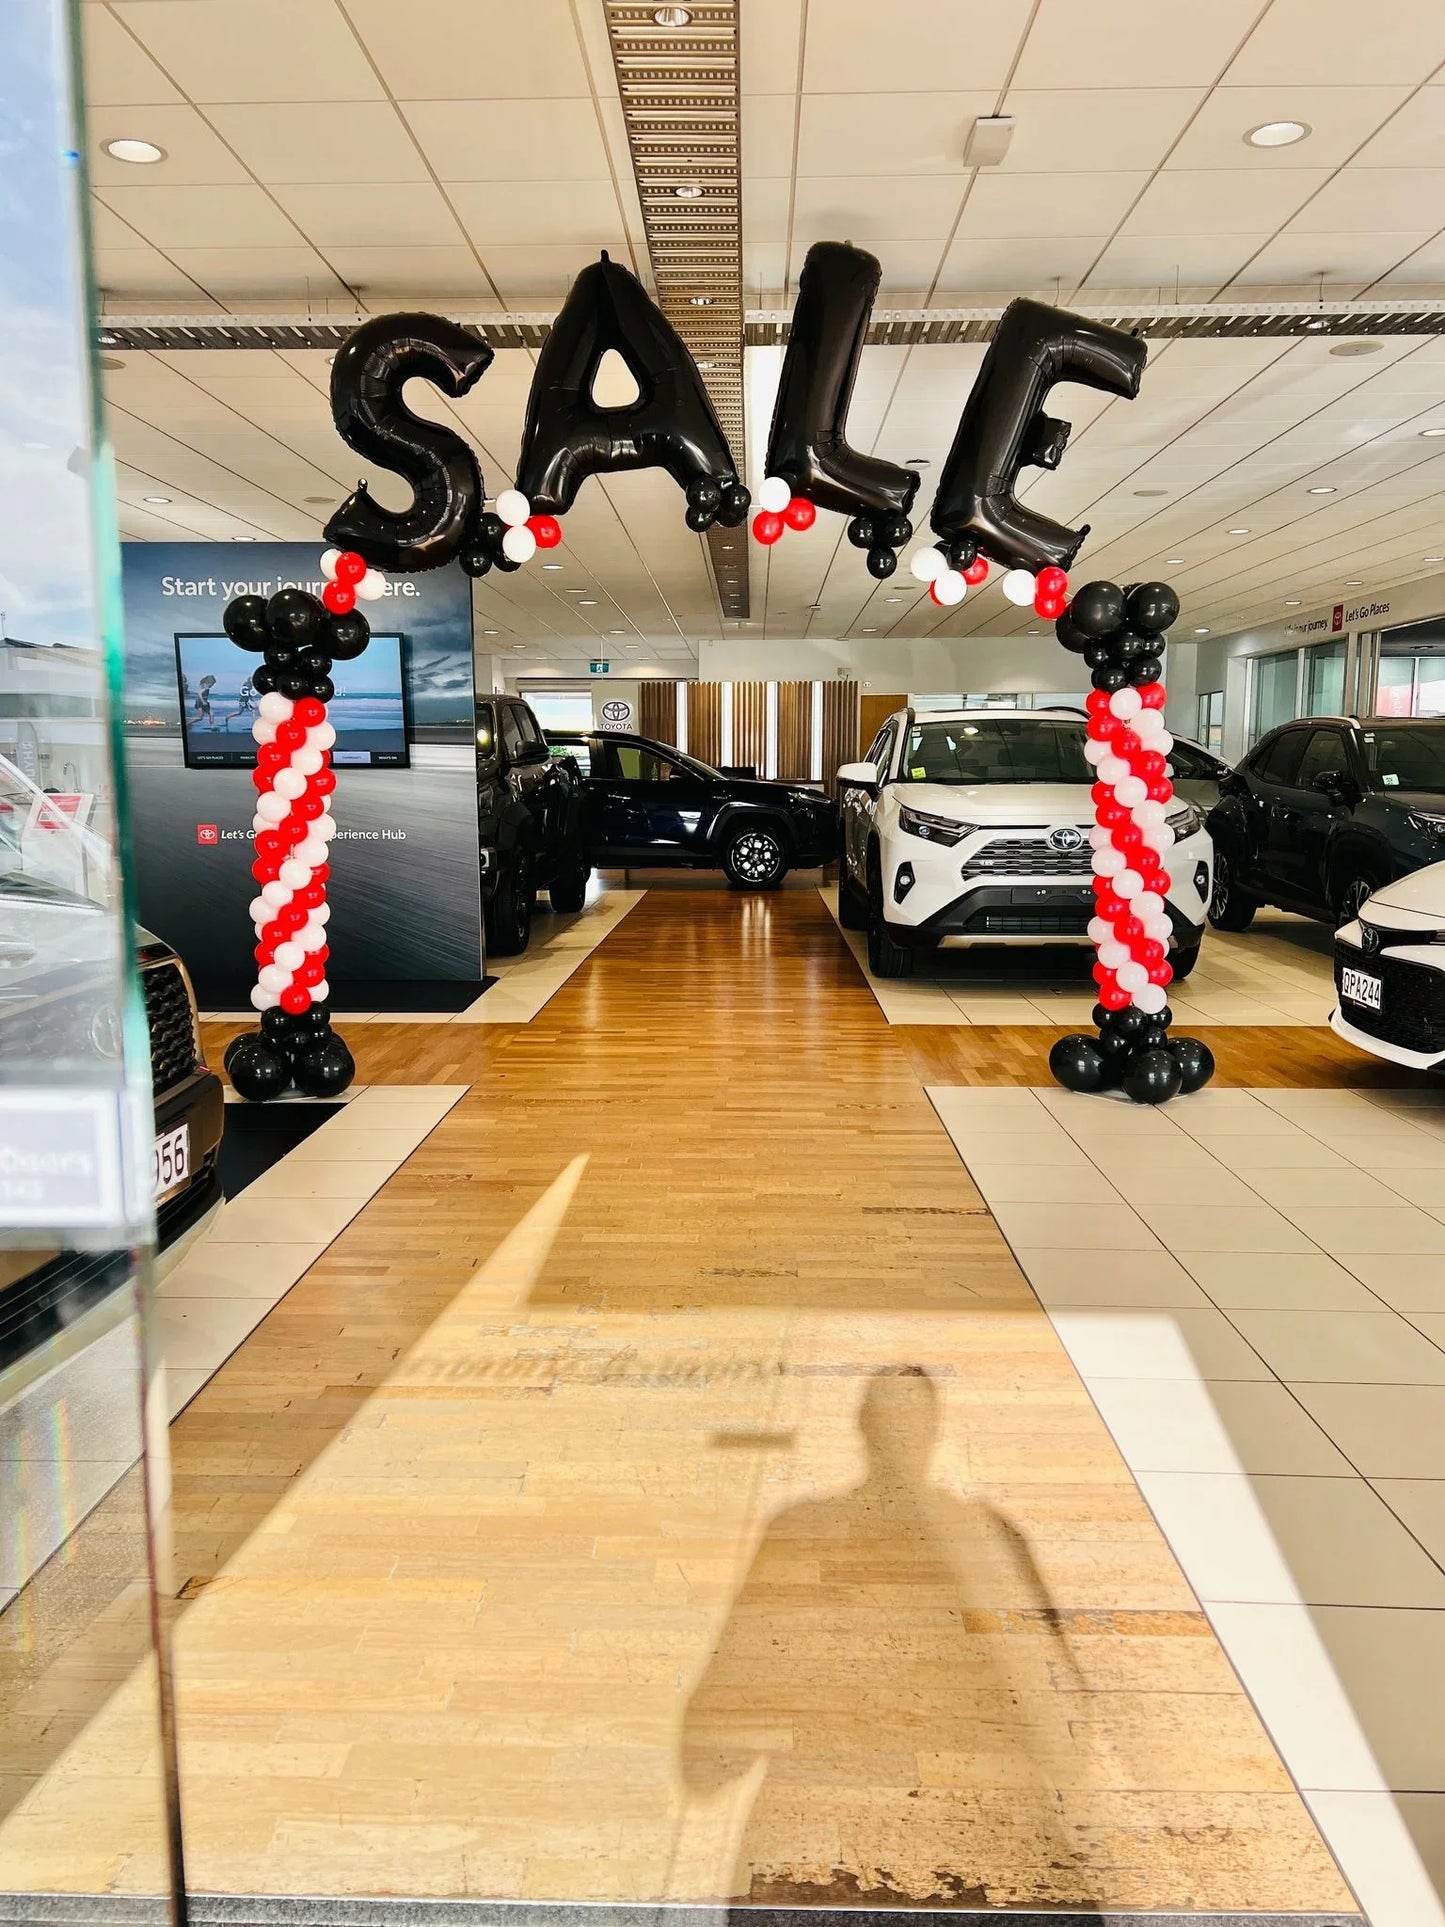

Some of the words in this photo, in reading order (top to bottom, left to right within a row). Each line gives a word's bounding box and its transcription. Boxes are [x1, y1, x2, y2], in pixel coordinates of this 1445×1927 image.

[323, 241, 1147, 573] SALE
[161, 576, 217, 596] Start
[221, 581, 272, 601] your
[384, 582, 420, 597] ere.
[1345, 608, 1359, 622] Let's
[1360, 606, 1369, 618] Go
[1370, 602, 1390, 616] Places
[600, 723, 633, 731] TOYOTA
[221, 829, 244, 840] Let's
[246, 830, 257, 840] G
[381, 829, 406, 840] Hub
[1344, 971, 1380, 1006] QPA244
